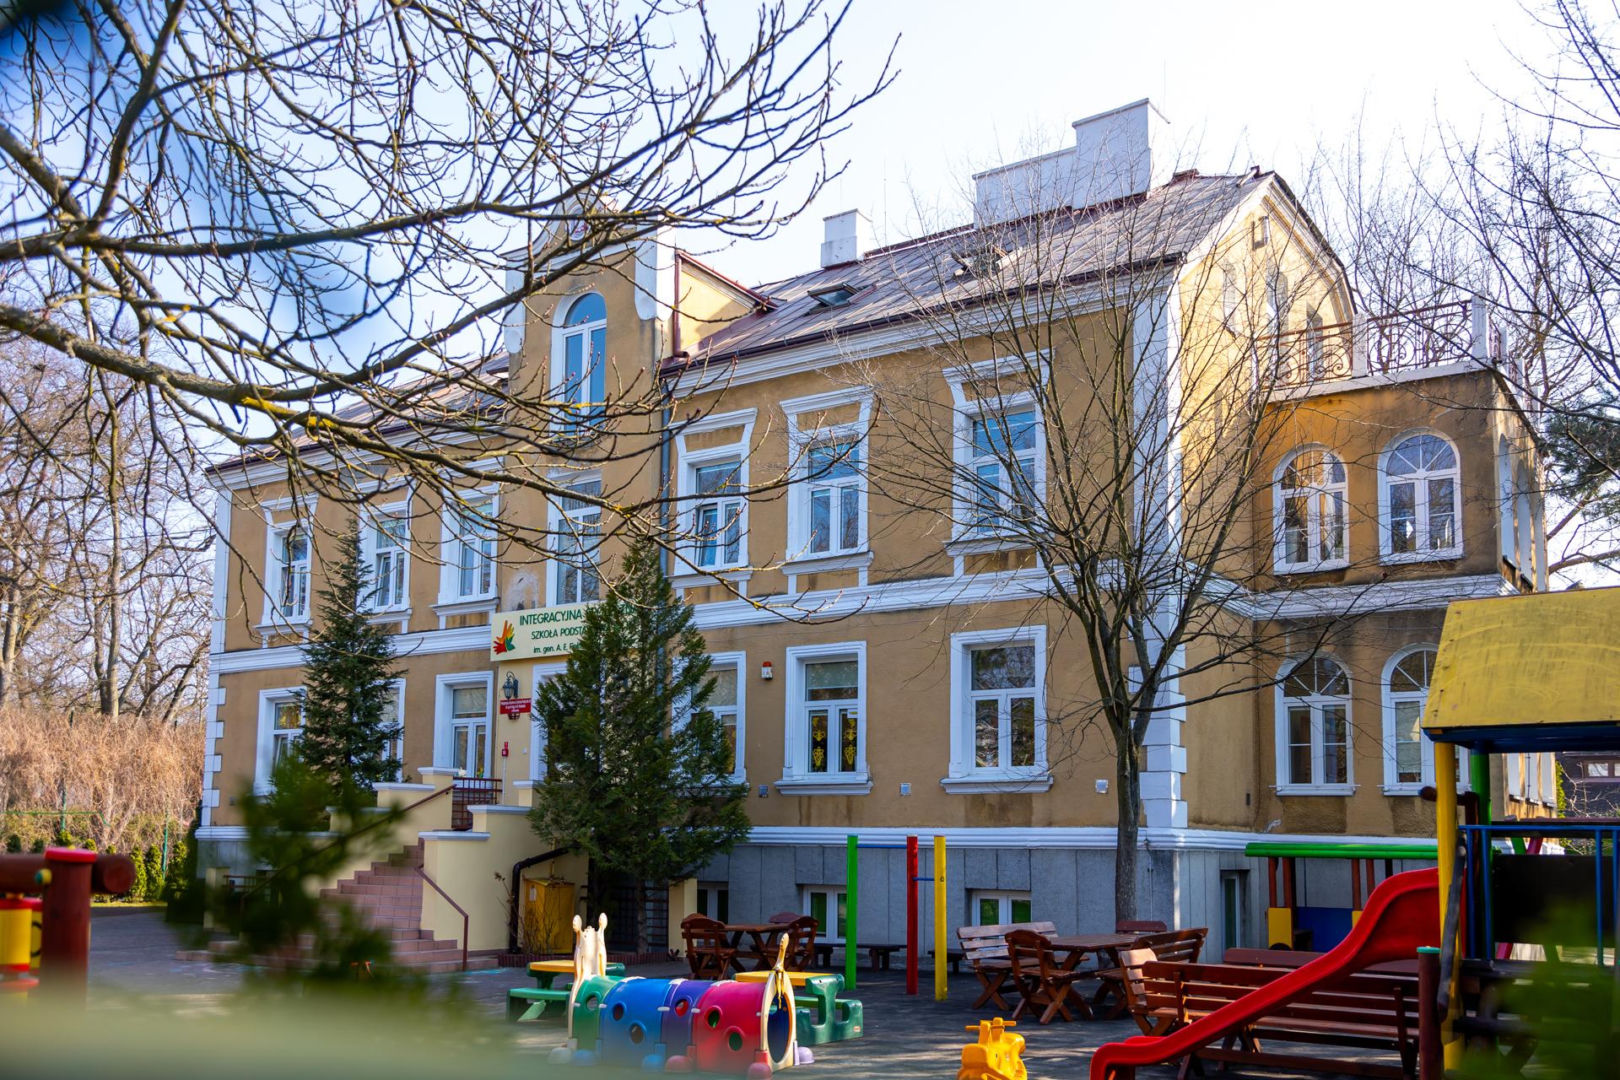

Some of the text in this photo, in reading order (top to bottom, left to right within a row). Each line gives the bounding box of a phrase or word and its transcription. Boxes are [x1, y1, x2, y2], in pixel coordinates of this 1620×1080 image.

[519, 609, 583, 626] INTEGRACYJNA
[531, 626, 588, 640] SZKOŁA PODSTA
